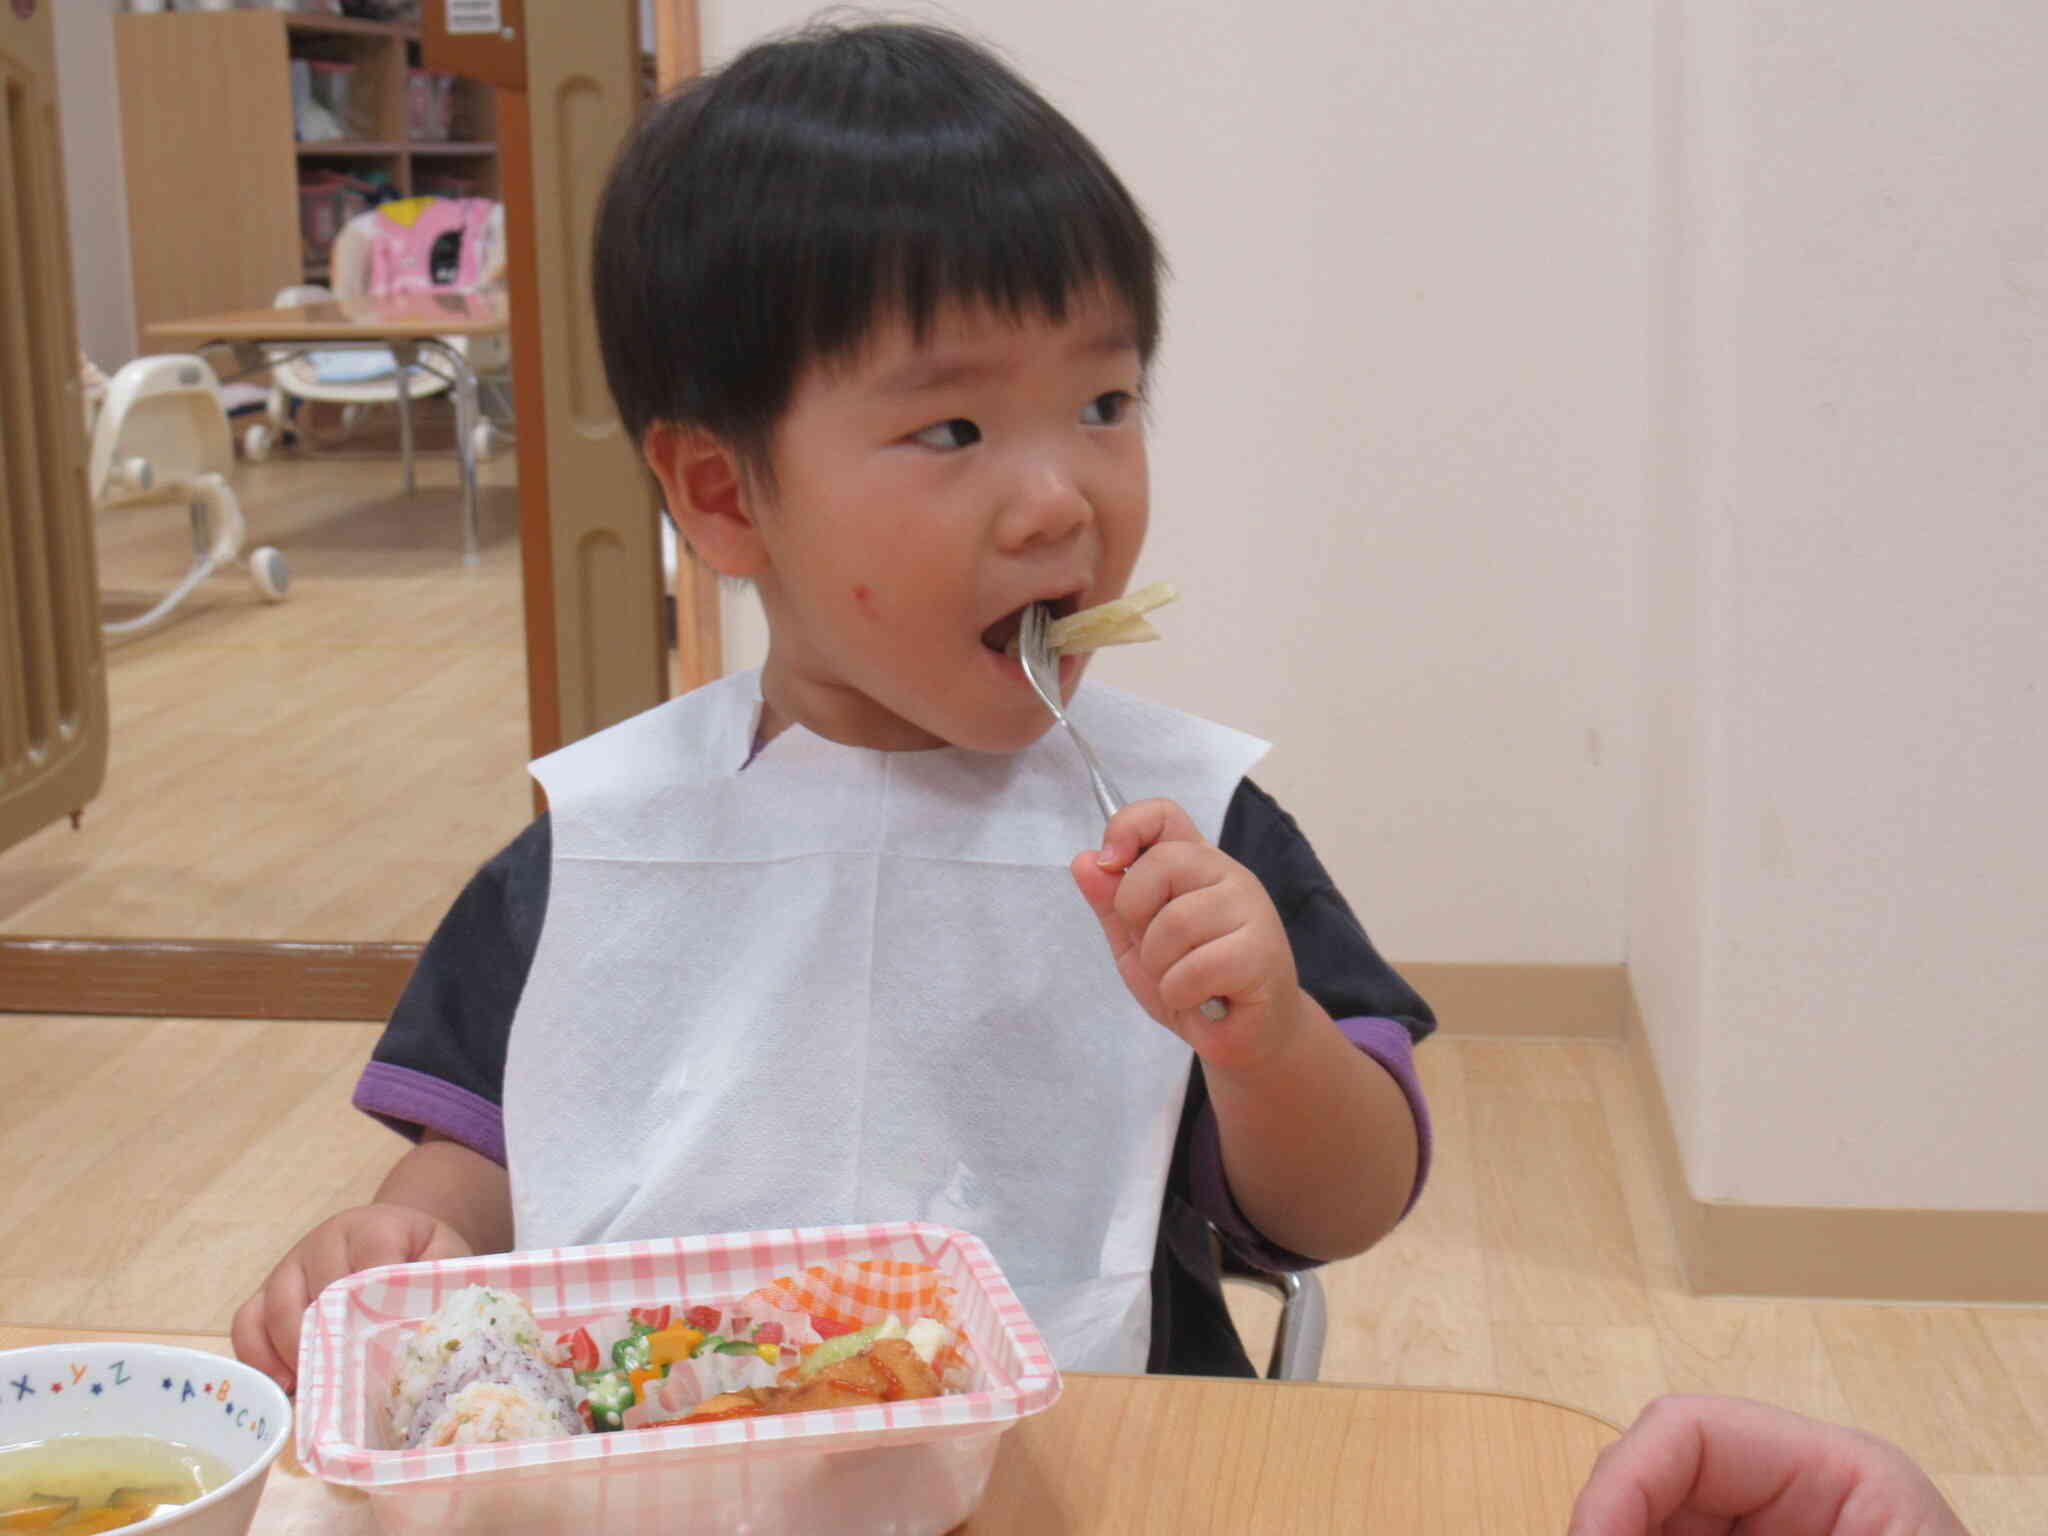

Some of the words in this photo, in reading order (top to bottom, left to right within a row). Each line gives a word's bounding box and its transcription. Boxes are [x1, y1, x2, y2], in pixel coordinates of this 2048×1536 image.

[9, 1374, 36, 1401] X
[69, 1361, 88, 1385] Y
[109, 1359, 132, 1385] Z
[181, 1379, 196, 1402] A
[216, 1379, 231, 1402] B
